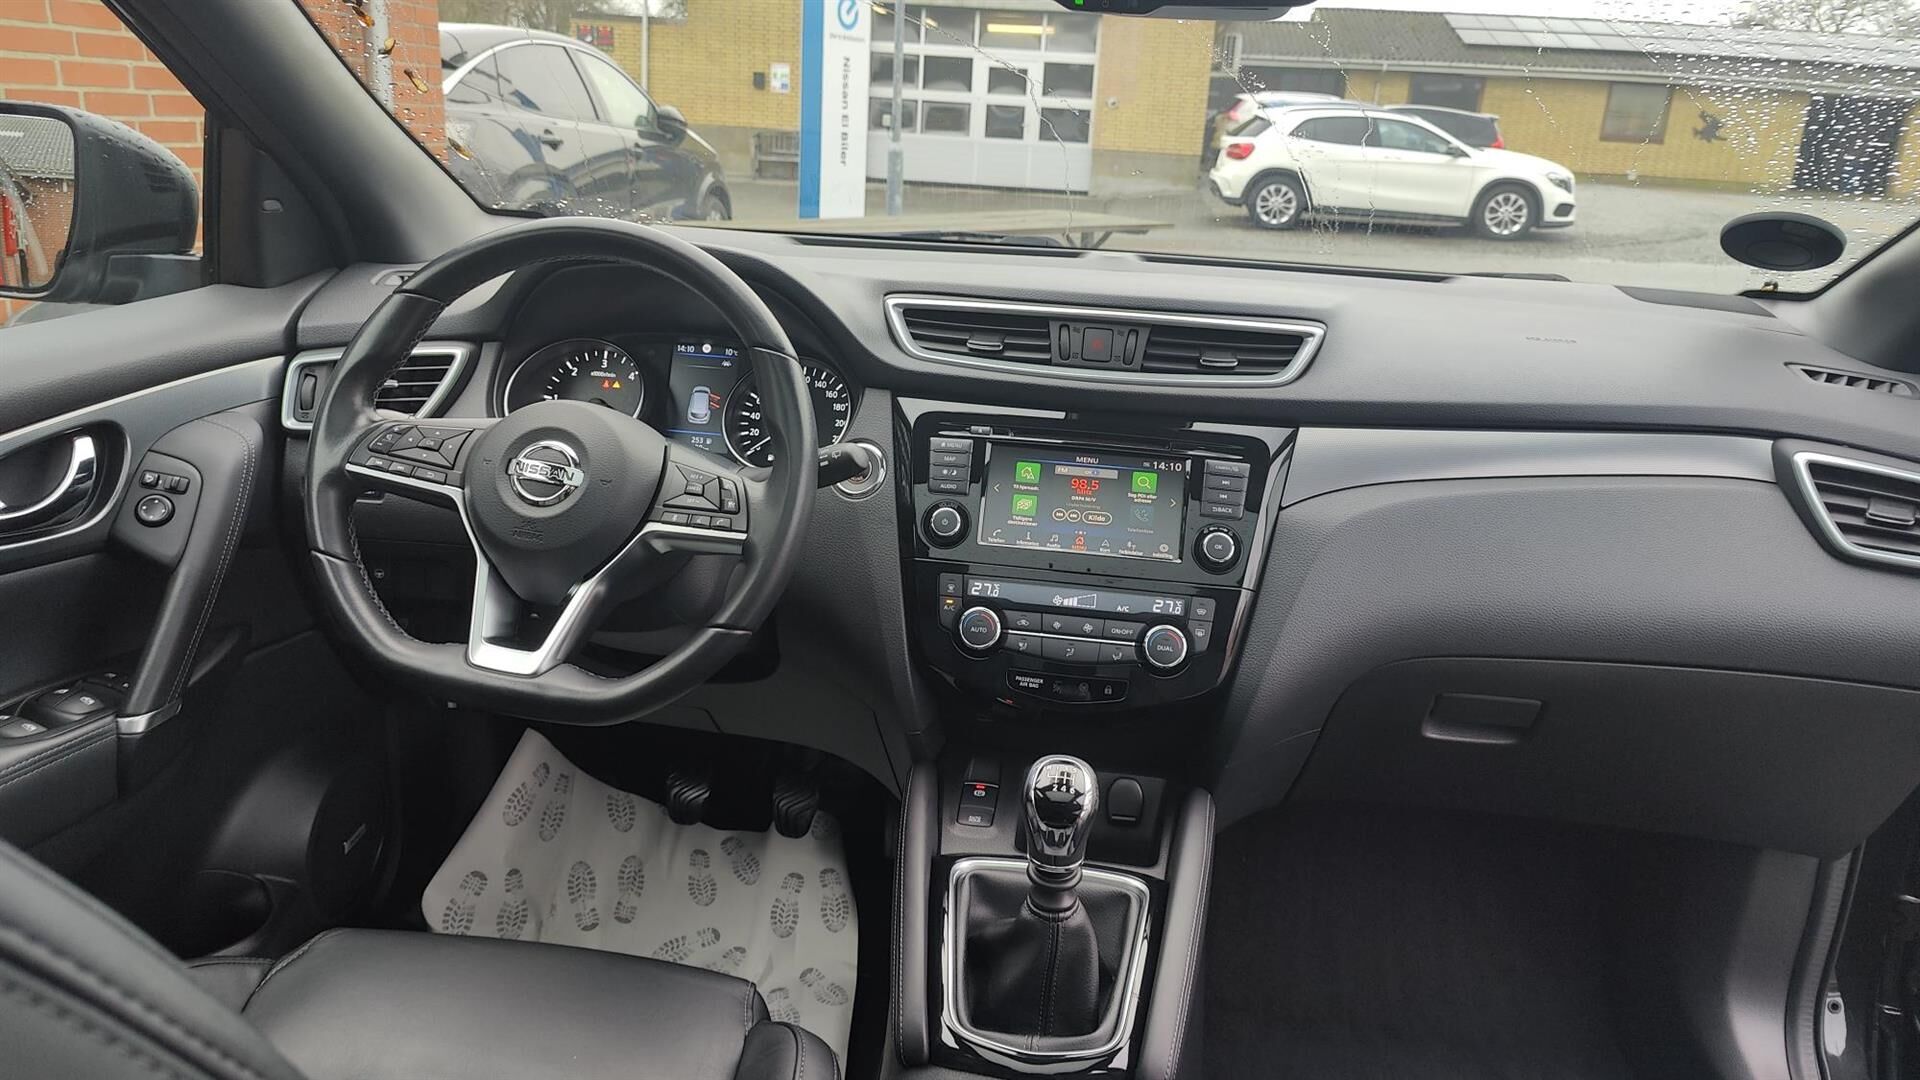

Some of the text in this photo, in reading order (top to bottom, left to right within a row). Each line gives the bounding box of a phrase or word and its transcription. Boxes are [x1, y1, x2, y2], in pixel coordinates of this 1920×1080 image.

[840, 56, 851, 167] Nissan El Biler
[677, 344, 695, 353] 14:10
[601, 359, 608, 368] 3
[571, 367, 578, 376] 2
[628, 372, 635, 381] 4
[815, 380, 827, 389] 140
[826, 390, 838, 399] 160
[833, 403, 846, 411] 180
[750, 412, 760, 421] 40
[750, 428, 760, 437] 20
[691, 436, 704, 444] 253
[1075, 456, 1099, 464] MENU
[1152, 461, 1182, 472] 14:10
[514, 461, 575, 482] NISSAN
[1071, 478, 1099, 490] 98.5
[1076, 488, 1093, 496] MHz
[1217, 506, 1233, 514] BACK
[1116, 605, 1130, 613] A/C
[1156, 644, 1174, 652] DUAL
[1015, 675, 1044, 684] PASSENGER
[1052, 784, 1058, 792] 2
[1070, 786, 1076, 794] 6
